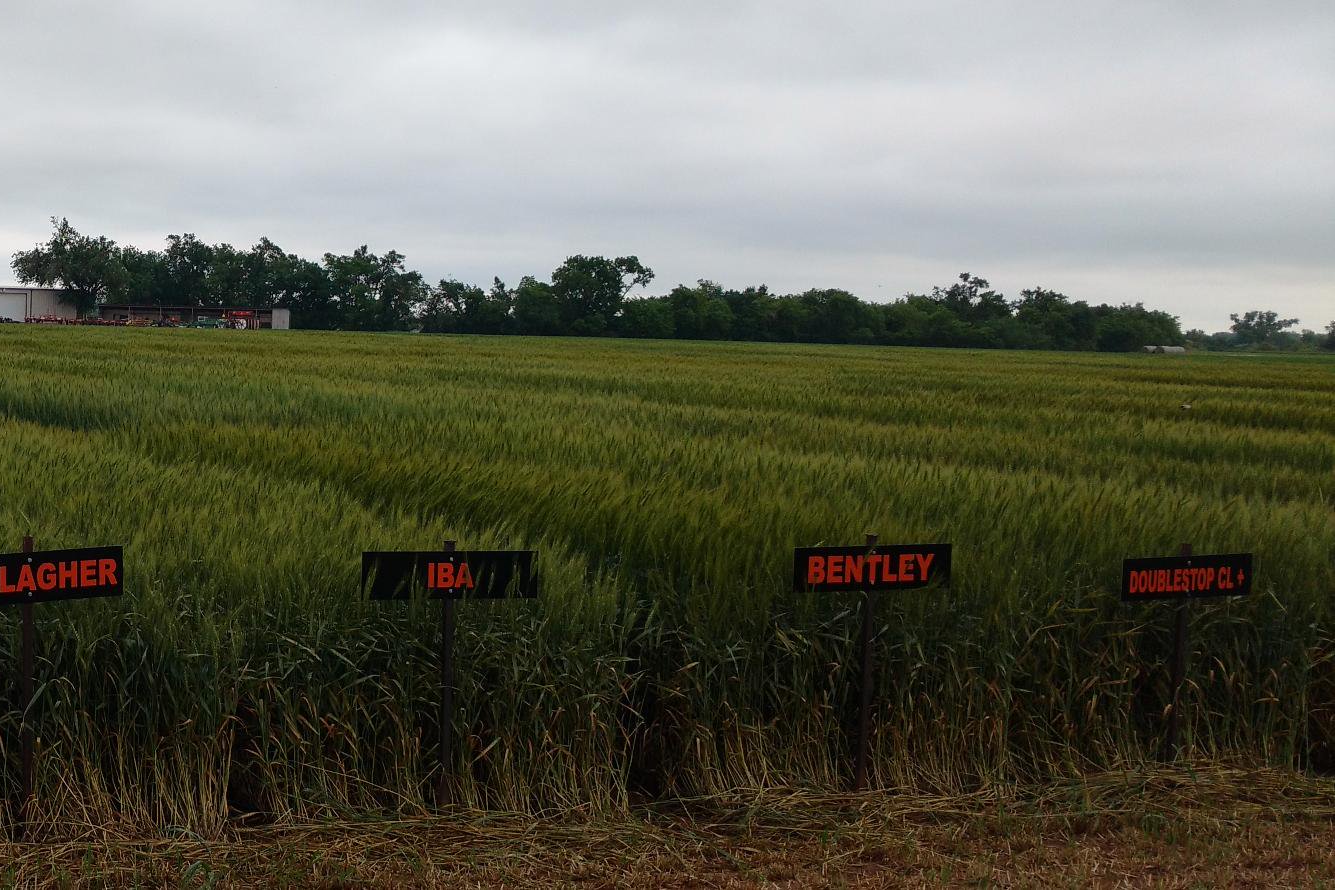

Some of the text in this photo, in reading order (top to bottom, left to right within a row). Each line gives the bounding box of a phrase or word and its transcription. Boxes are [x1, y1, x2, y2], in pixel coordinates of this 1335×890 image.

[427, 562, 474, 588] IBA
[807, 553, 935, 585] BENTLEY
[1129, 567, 1215, 593] DOUBLESTOP
[1218, 566, 1234, 589] CL
